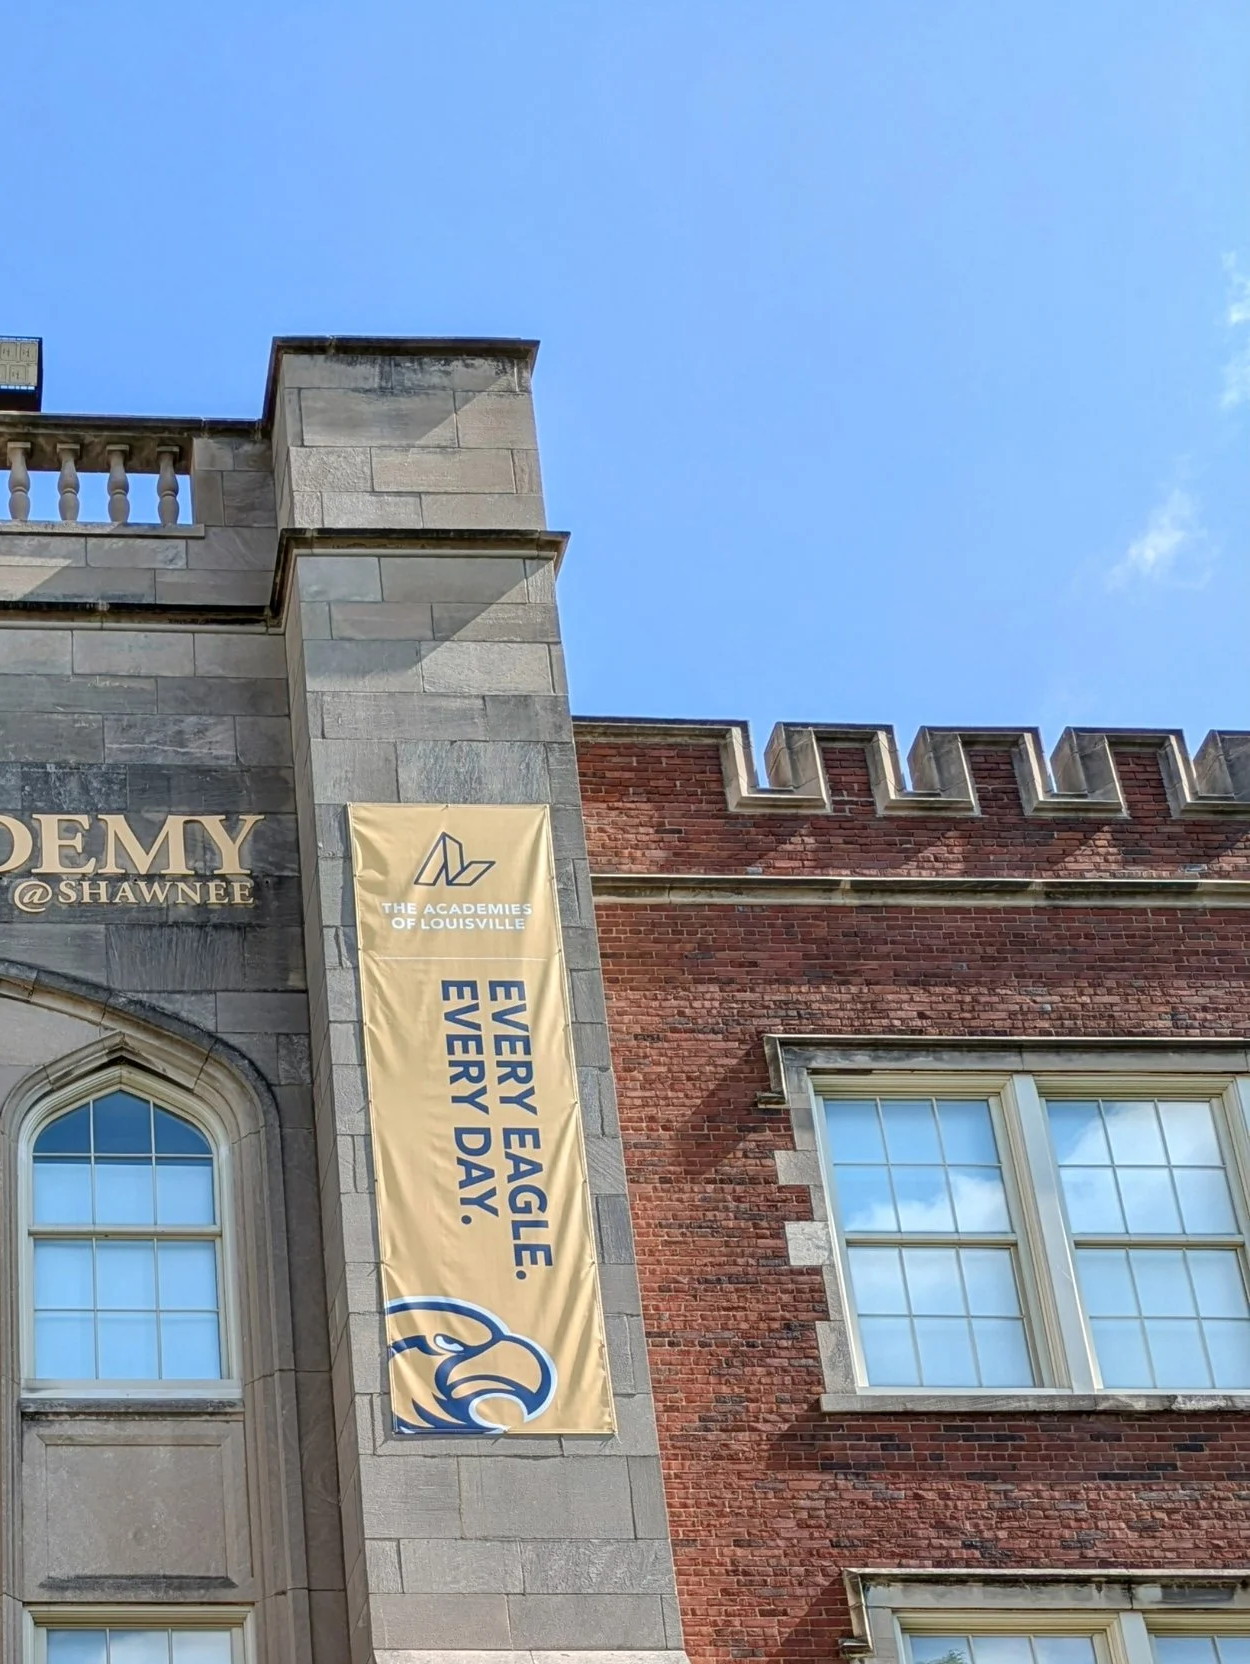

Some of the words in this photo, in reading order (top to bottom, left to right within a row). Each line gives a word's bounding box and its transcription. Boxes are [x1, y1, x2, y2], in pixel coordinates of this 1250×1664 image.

[13, 878, 255, 912] @SHAWNEE
[382, 902, 418, 917] THE
[423, 902, 532, 918] ACADEMIES
[391, 916, 418, 931] OF
[420, 916, 526, 931] LOUISVILLE
[440, 979, 490, 1115] EVERY
[488, 979, 538, 1116] EVERY
[454, 1125, 499, 1226] DAY.
[502, 1127, 553, 1281] EAGLE.
